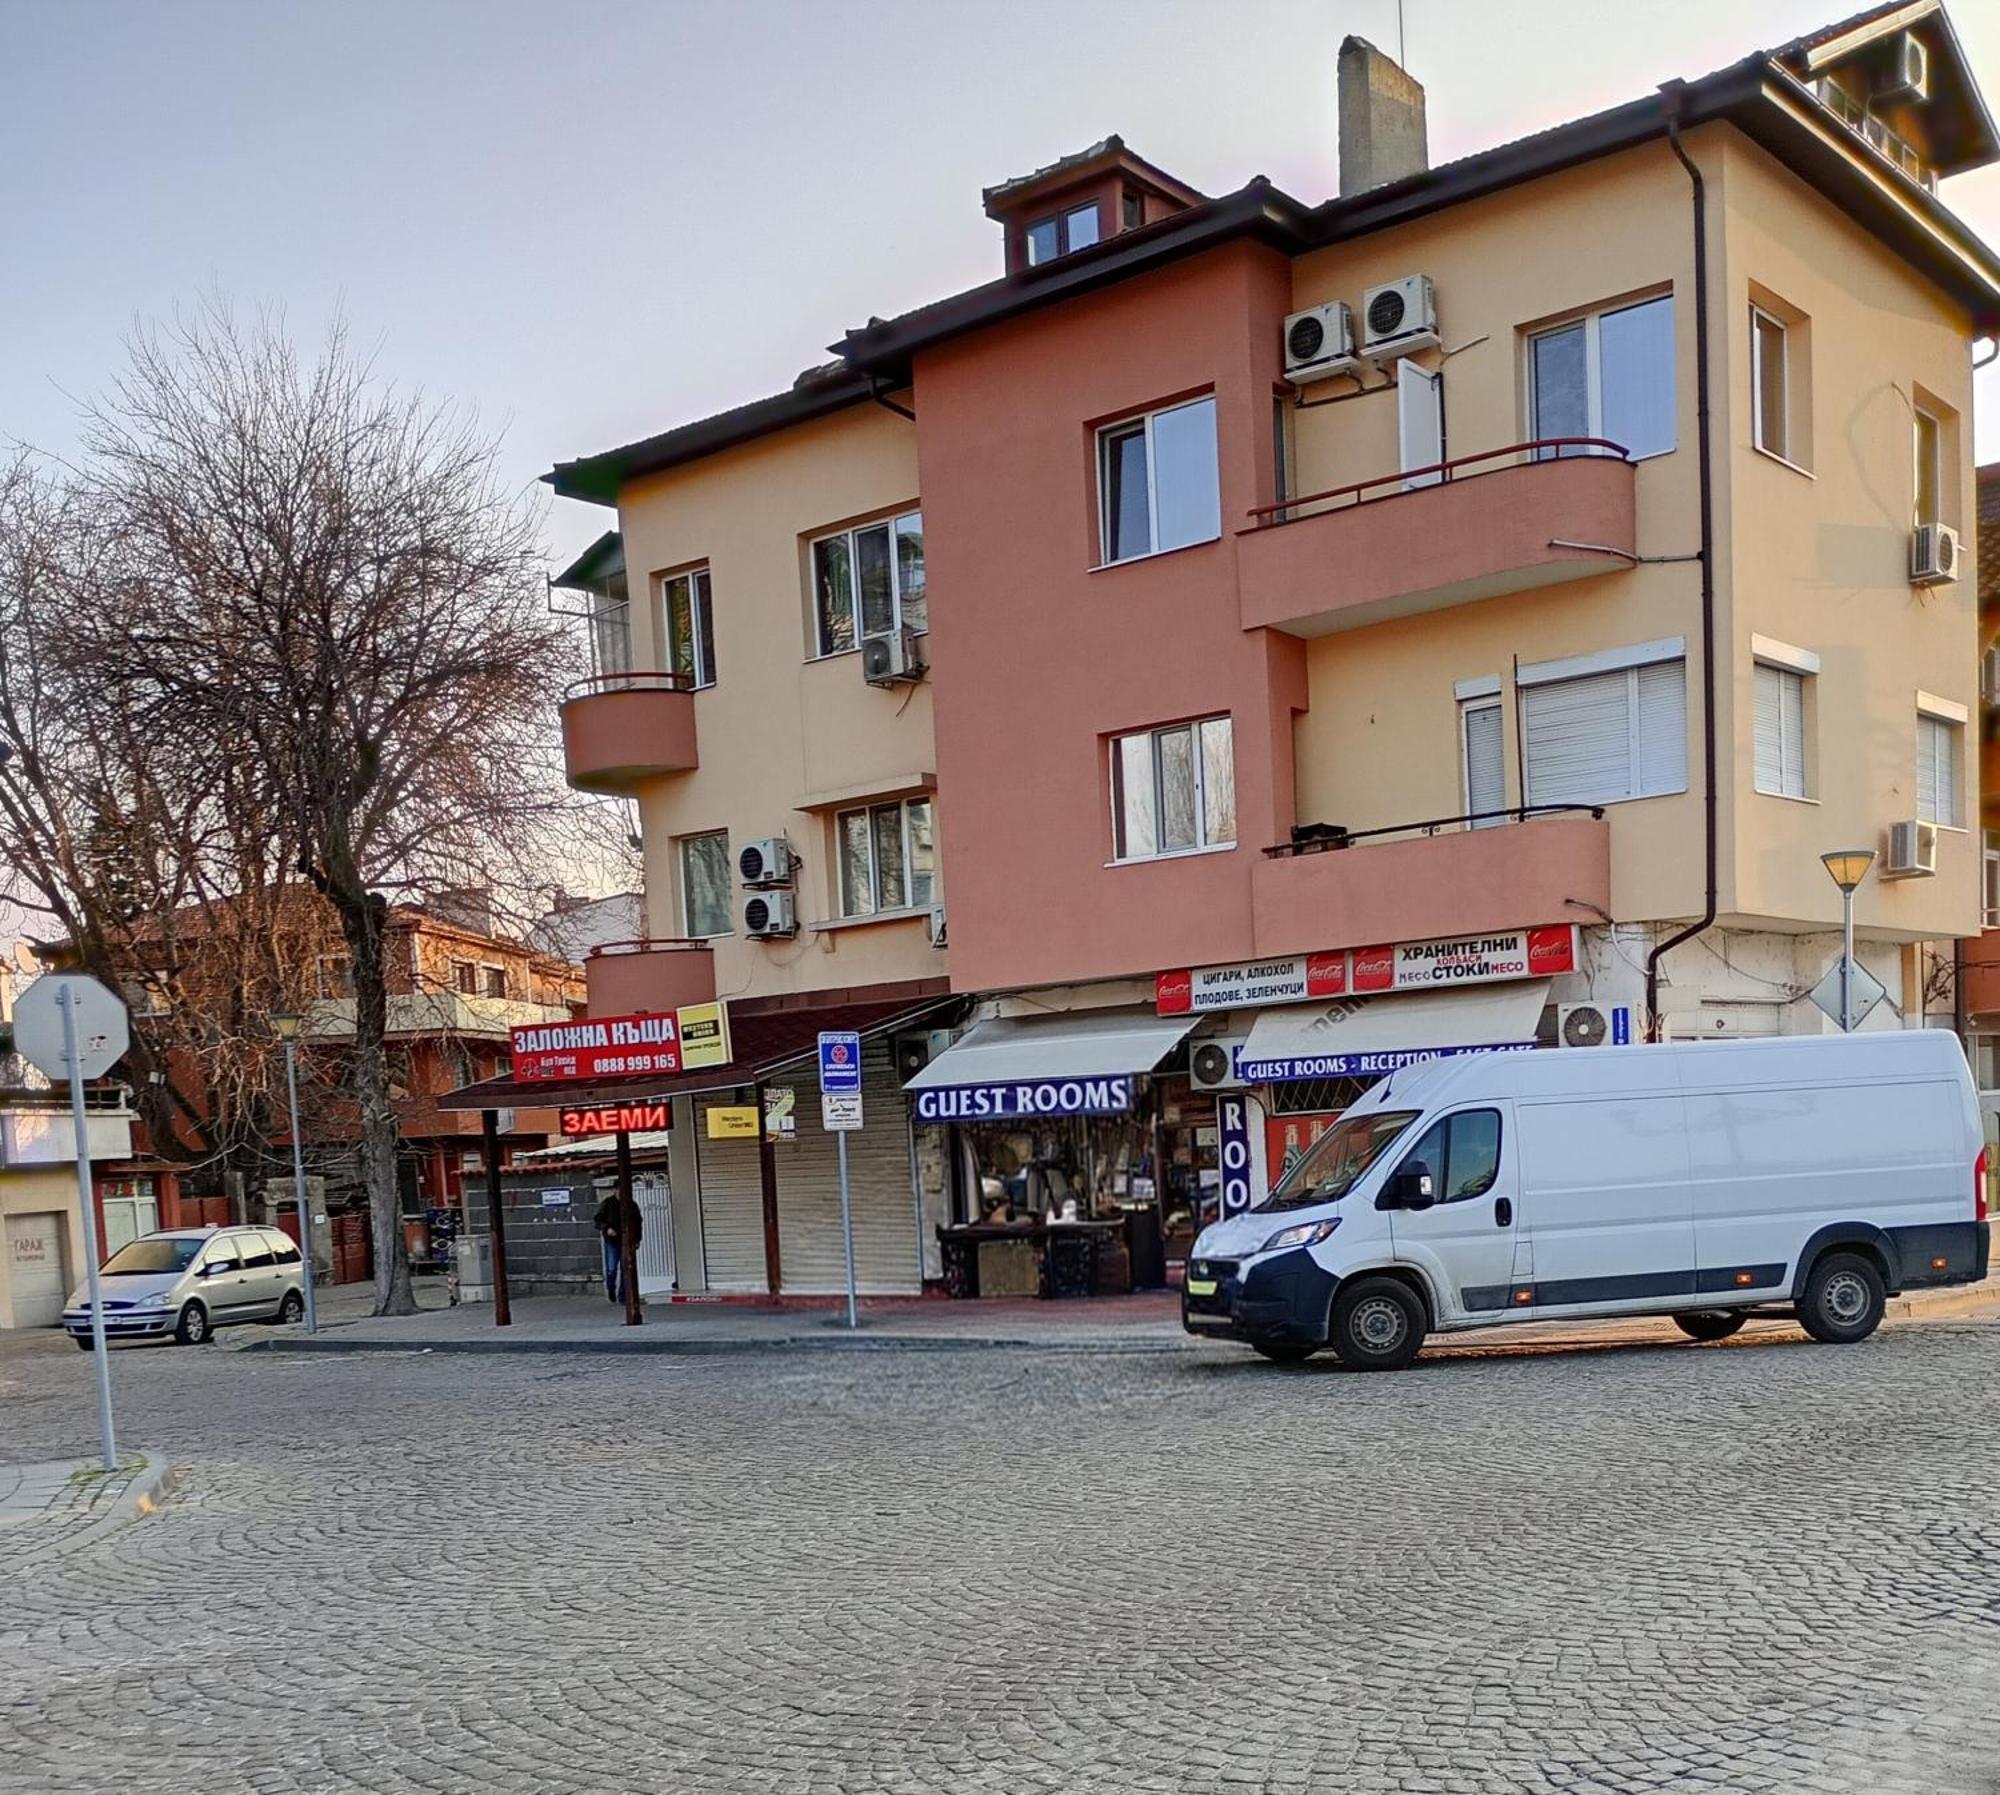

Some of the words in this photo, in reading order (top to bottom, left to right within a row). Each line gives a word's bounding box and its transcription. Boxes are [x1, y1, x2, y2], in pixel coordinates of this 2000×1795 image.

[1402, 937, 1517, 961] ХРАНИТЕЛНИ
[1436, 954, 1482, 965] КОЛБАСИ
[1203, 970, 1244, 985] ЦИГАРИ,
[1247, 963, 1294, 979] АЛКОХОЛ
[1432, 962, 1490, 980] СТОКИ
[1491, 961, 1524, 974] МЕСО
[1195, 989, 1243, 1005] ПЛОДОВЕ,
[1246, 982, 1304, 999] ЗЕЛЕНЧУЦИ
[514, 1024, 608, 1053] ЗАЛОЖНА
[611, 1018, 675, 1045] КЪЩА
[594, 1057, 625, 1073] 0888
[627, 1055, 651, 1070] 999
[653, 1053, 676, 1069] 165
[1248, 1062, 1290, 1078] GUEST
[1295, 1057, 1346, 1075] ROOMS
[918, 1088, 1006, 1118] GUEST
[1015, 1079, 1128, 1112] ROOMS
[563, 1106, 666, 1133] ЗАЕМИ
